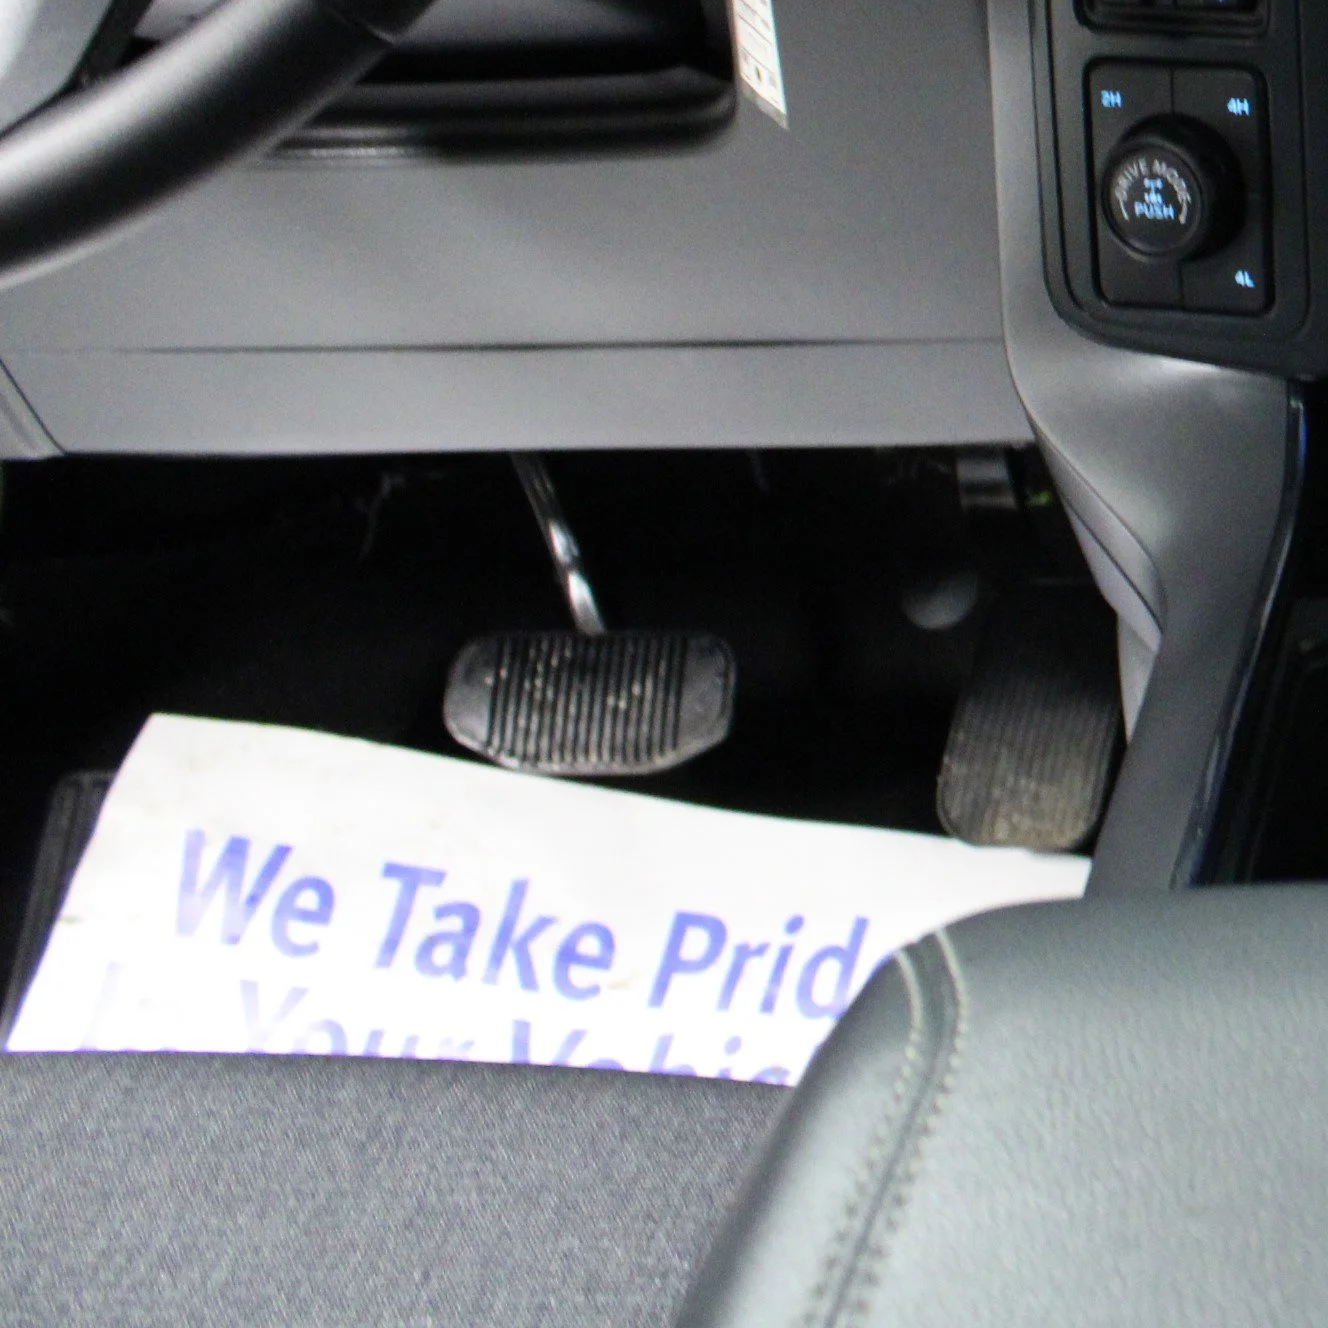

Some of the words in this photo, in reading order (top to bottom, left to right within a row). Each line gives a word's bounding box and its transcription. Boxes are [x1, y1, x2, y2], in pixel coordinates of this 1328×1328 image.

[1227, 97, 1250, 116] 4H
[1135, 201, 1175, 220] PUSH
[172, 828, 335, 958] We
[371, 861, 616, 1001] Take
